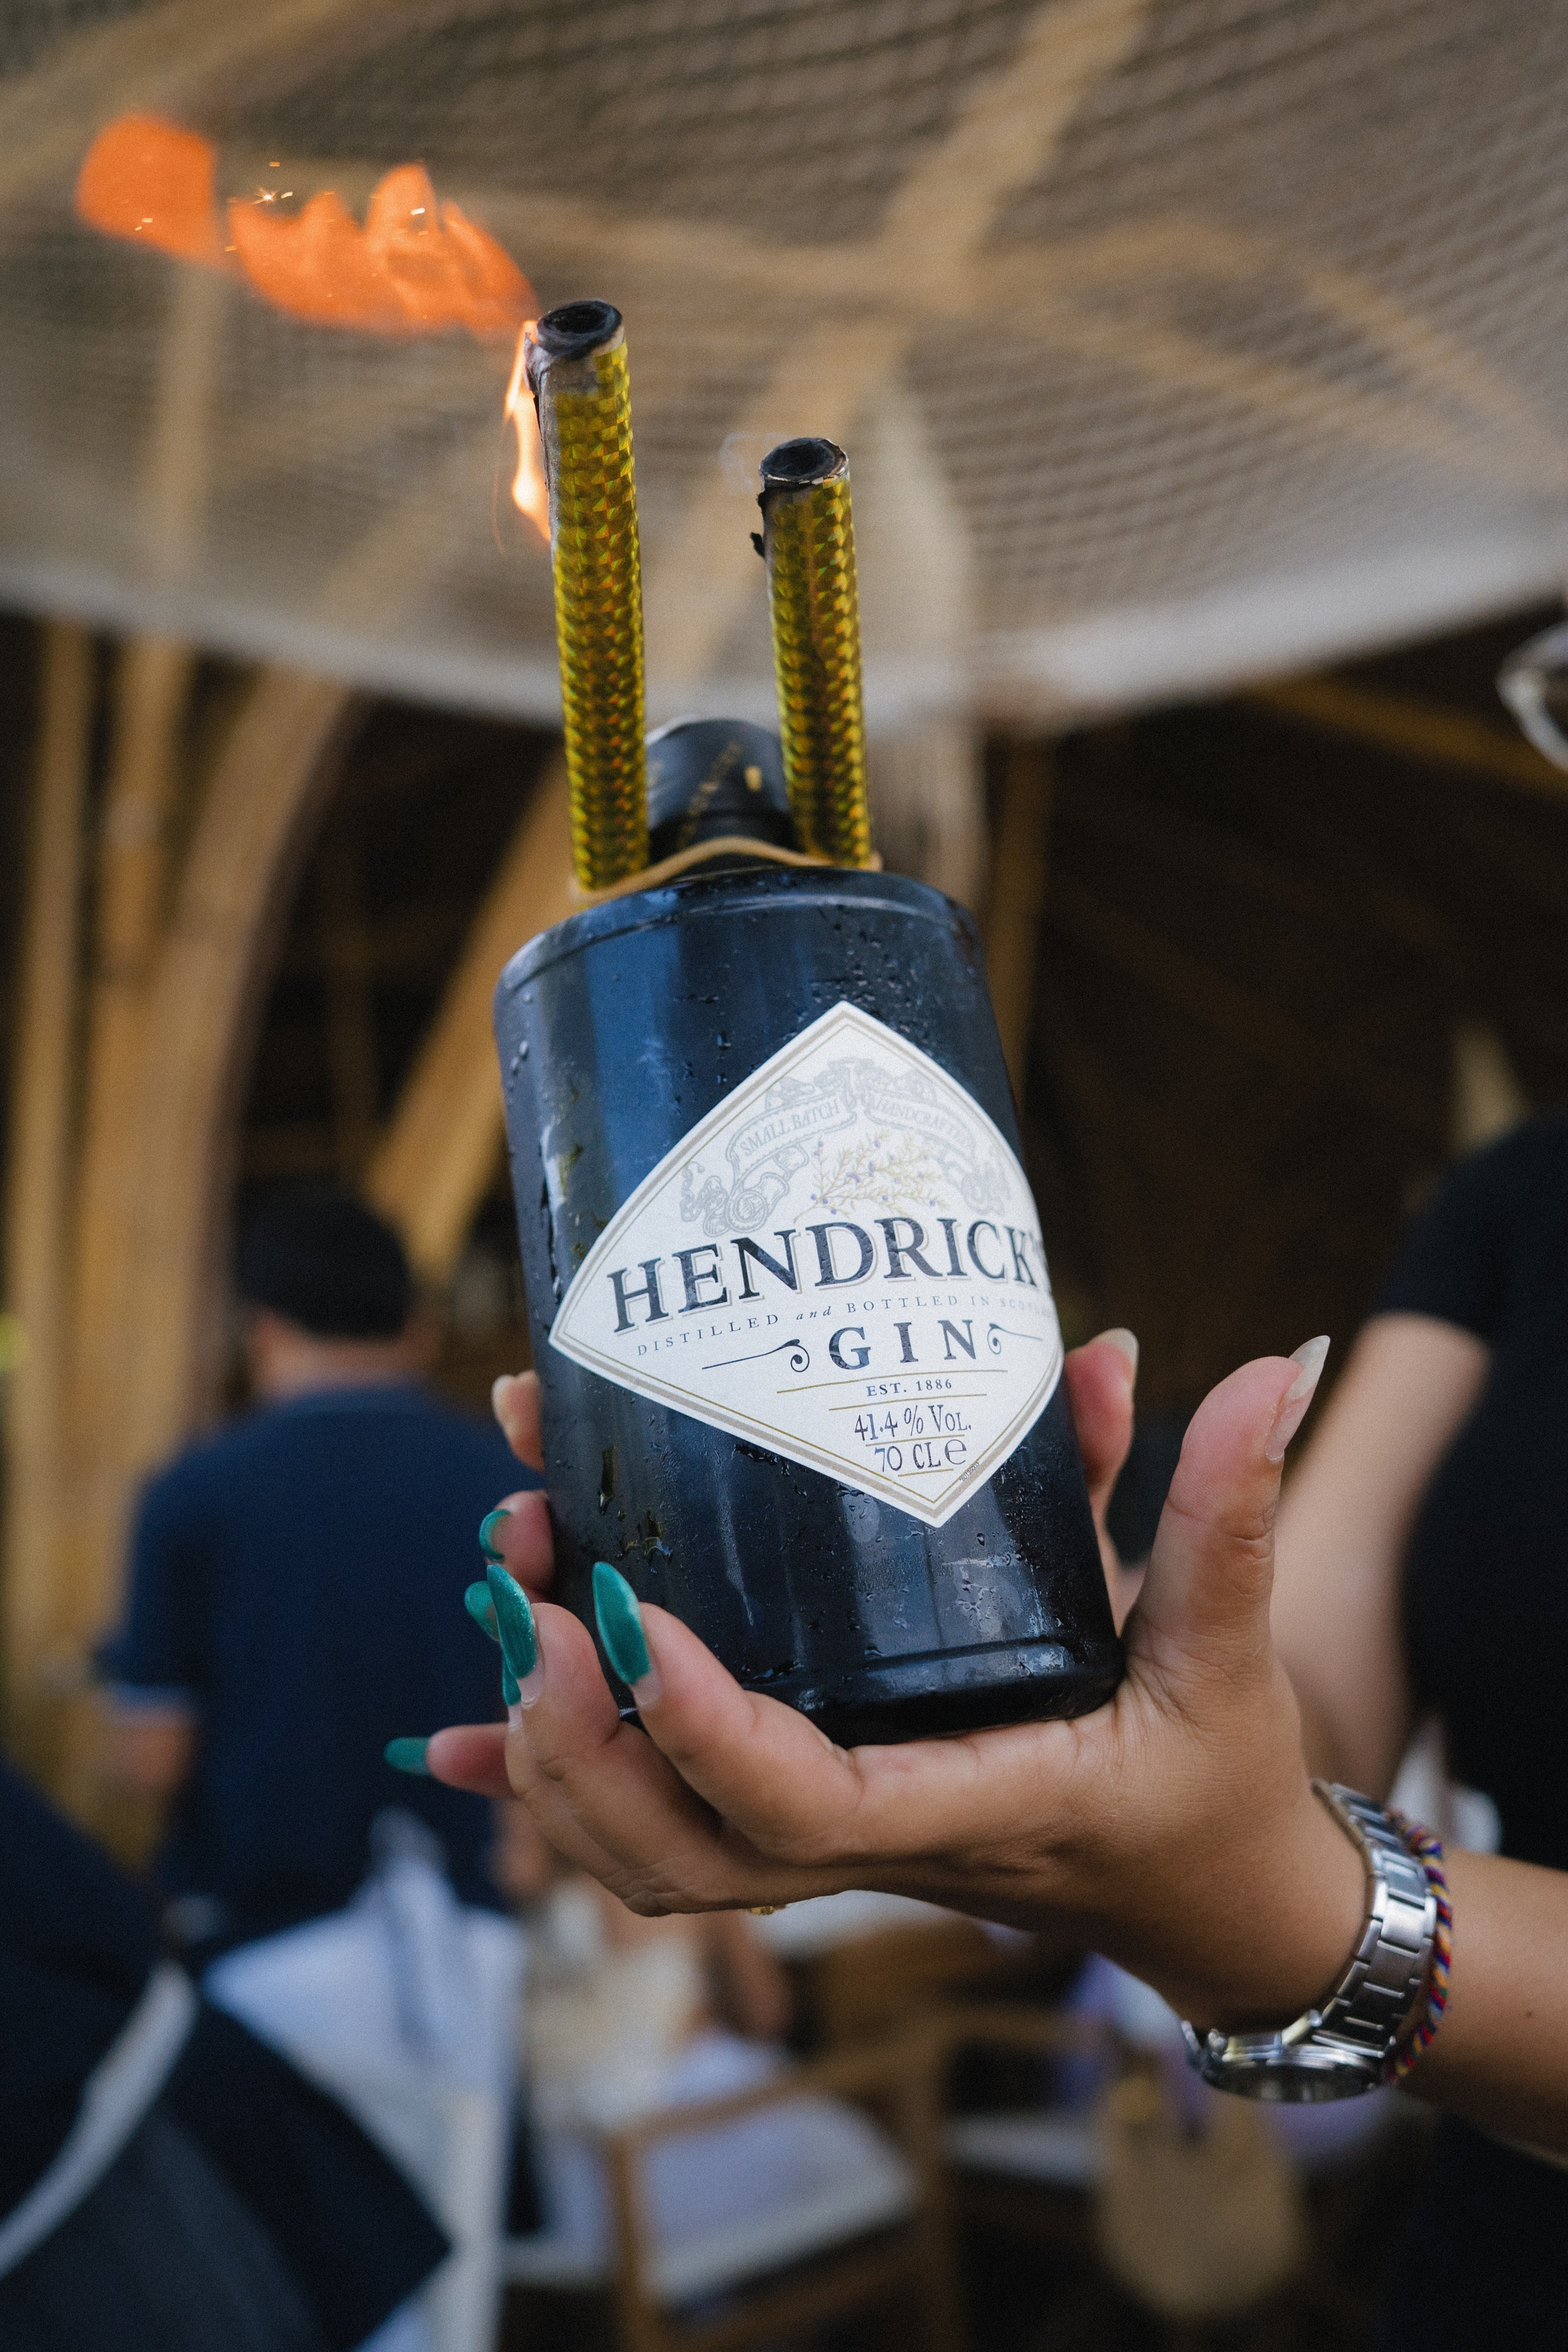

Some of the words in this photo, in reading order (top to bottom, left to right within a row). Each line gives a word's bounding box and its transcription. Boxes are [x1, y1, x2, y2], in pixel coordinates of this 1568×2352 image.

[740, 1119, 790, 1156] SMALL
[791, 1099, 839, 1129] BATCH
[637, 1314, 778, 1355] DISTILLED
[796, 1306, 831, 1321] and
[846, 1295, 957, 1313] BOTTLED
[970, 1295, 989, 1306] IN
[829, 1319, 976, 1370] GIN
[866, 1382, 907, 1396] EST.
[916, 1379, 952, 1391] 1886
[874, 1446, 903, 1472] 70
